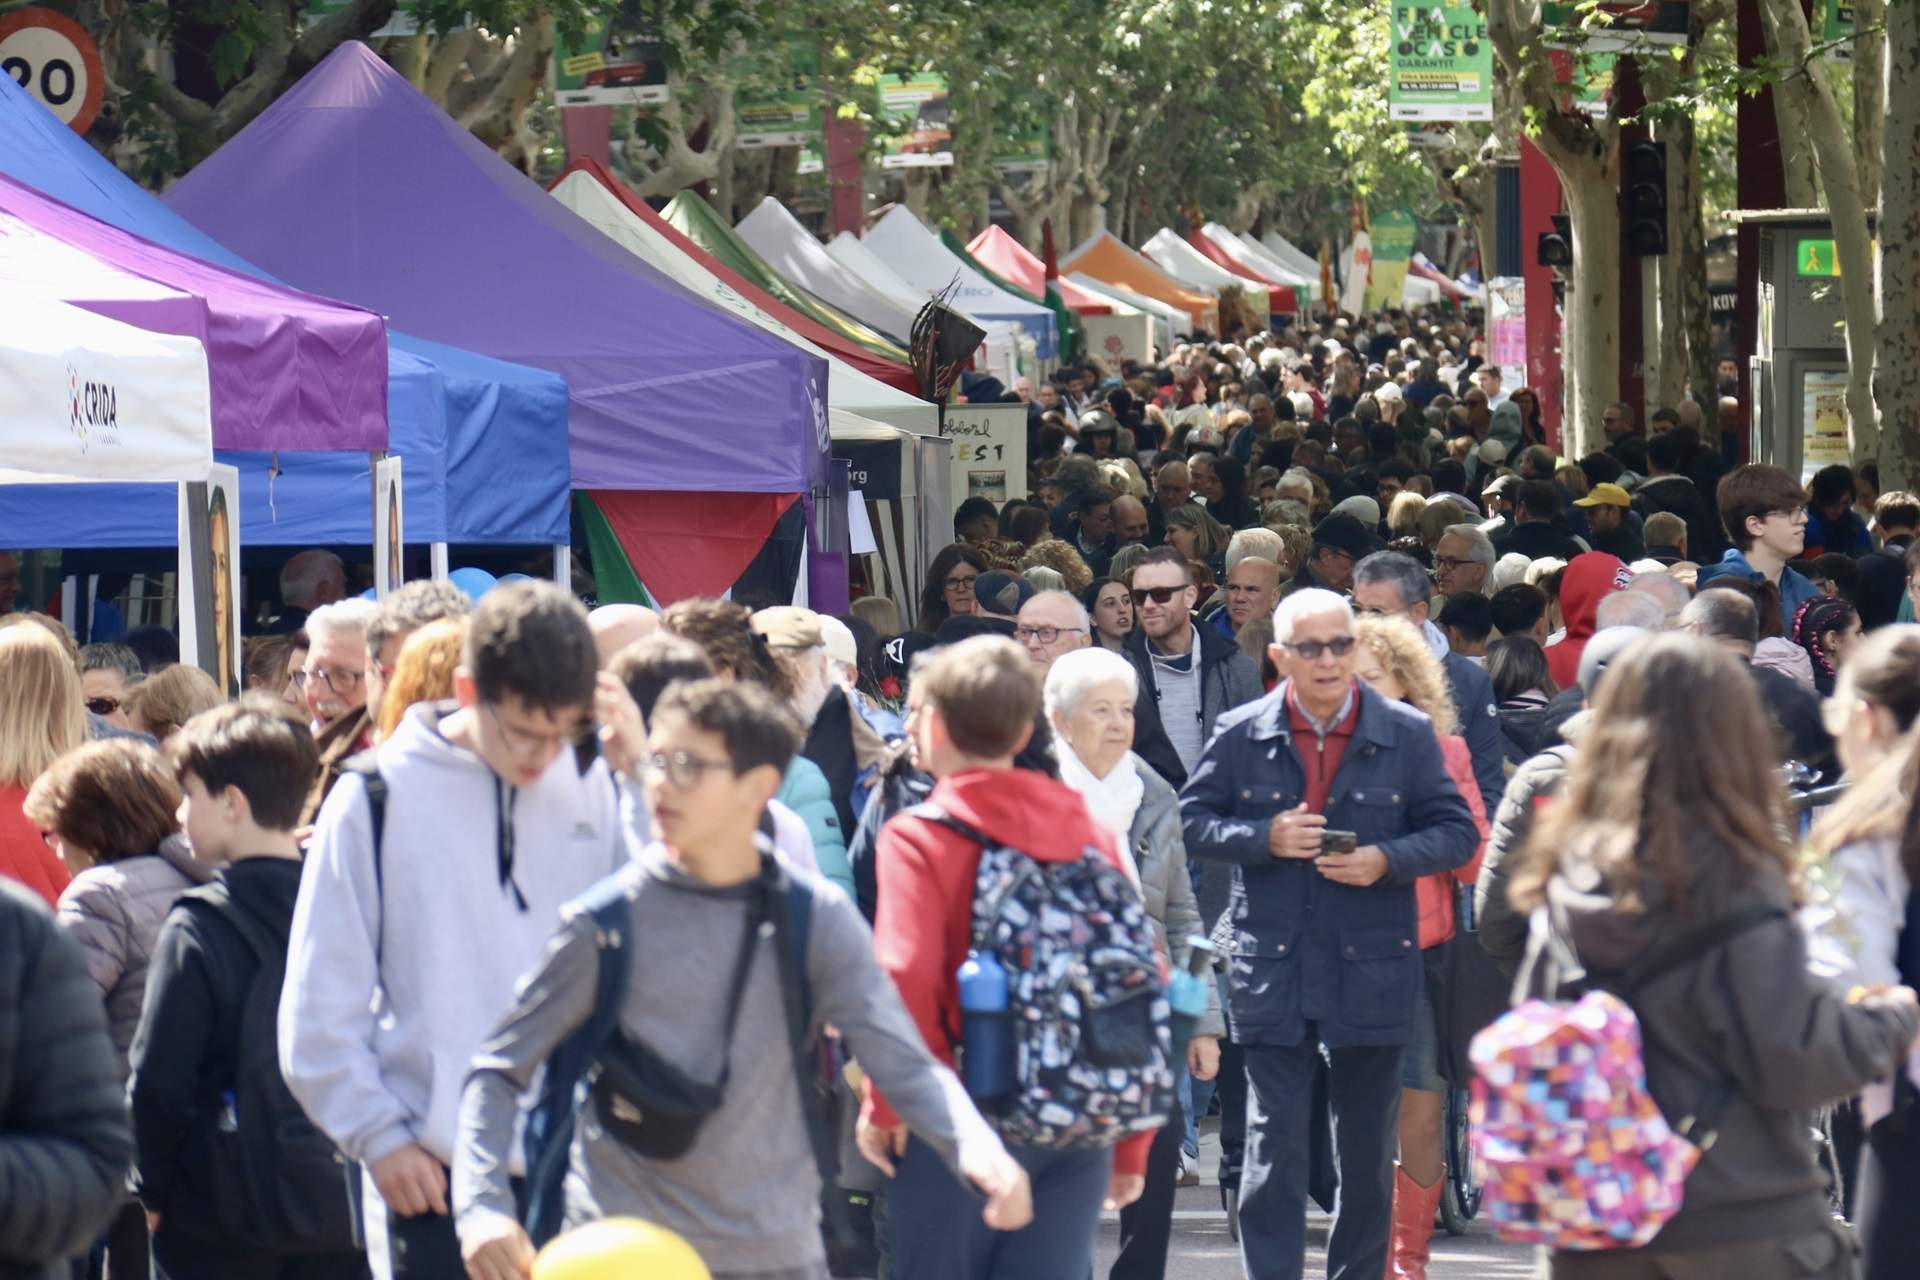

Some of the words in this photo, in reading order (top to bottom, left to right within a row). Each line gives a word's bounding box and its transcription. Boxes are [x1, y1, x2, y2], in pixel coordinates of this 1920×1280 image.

[1397, 7, 1446, 23] FIRA
[1397, 24, 1487, 40] VEHICLE
[1397, 59, 1455, 68] GARANTIT
[84, 380, 118, 429] CRIDA
[950, 443, 1005, 463] EST
